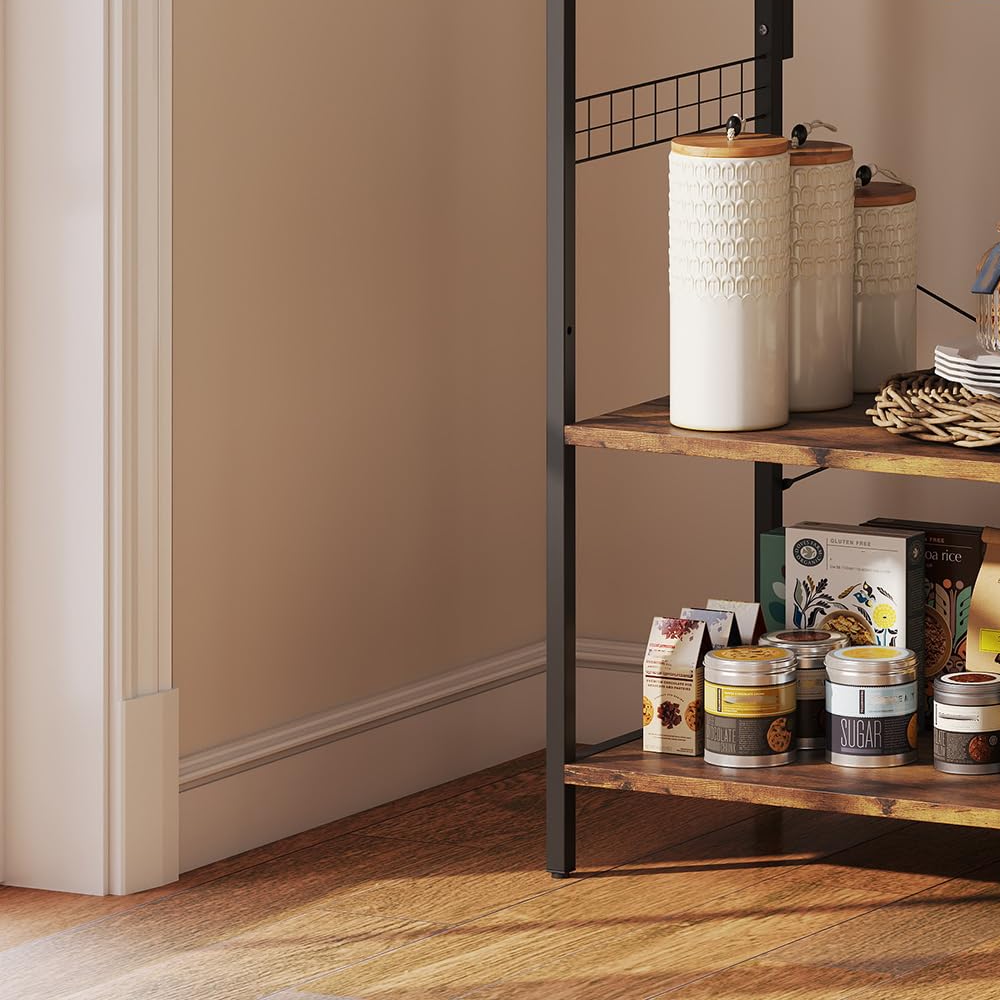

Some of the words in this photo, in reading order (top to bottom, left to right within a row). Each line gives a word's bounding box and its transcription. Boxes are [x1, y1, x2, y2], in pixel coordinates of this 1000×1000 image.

[830, 538, 854, 546] GLUTEN
[855, 540, 872, 548] FREE
[924, 550, 938, 561] oa
[941, 549, 962, 563] rice
[840, 718, 882, 749] SUGAR
